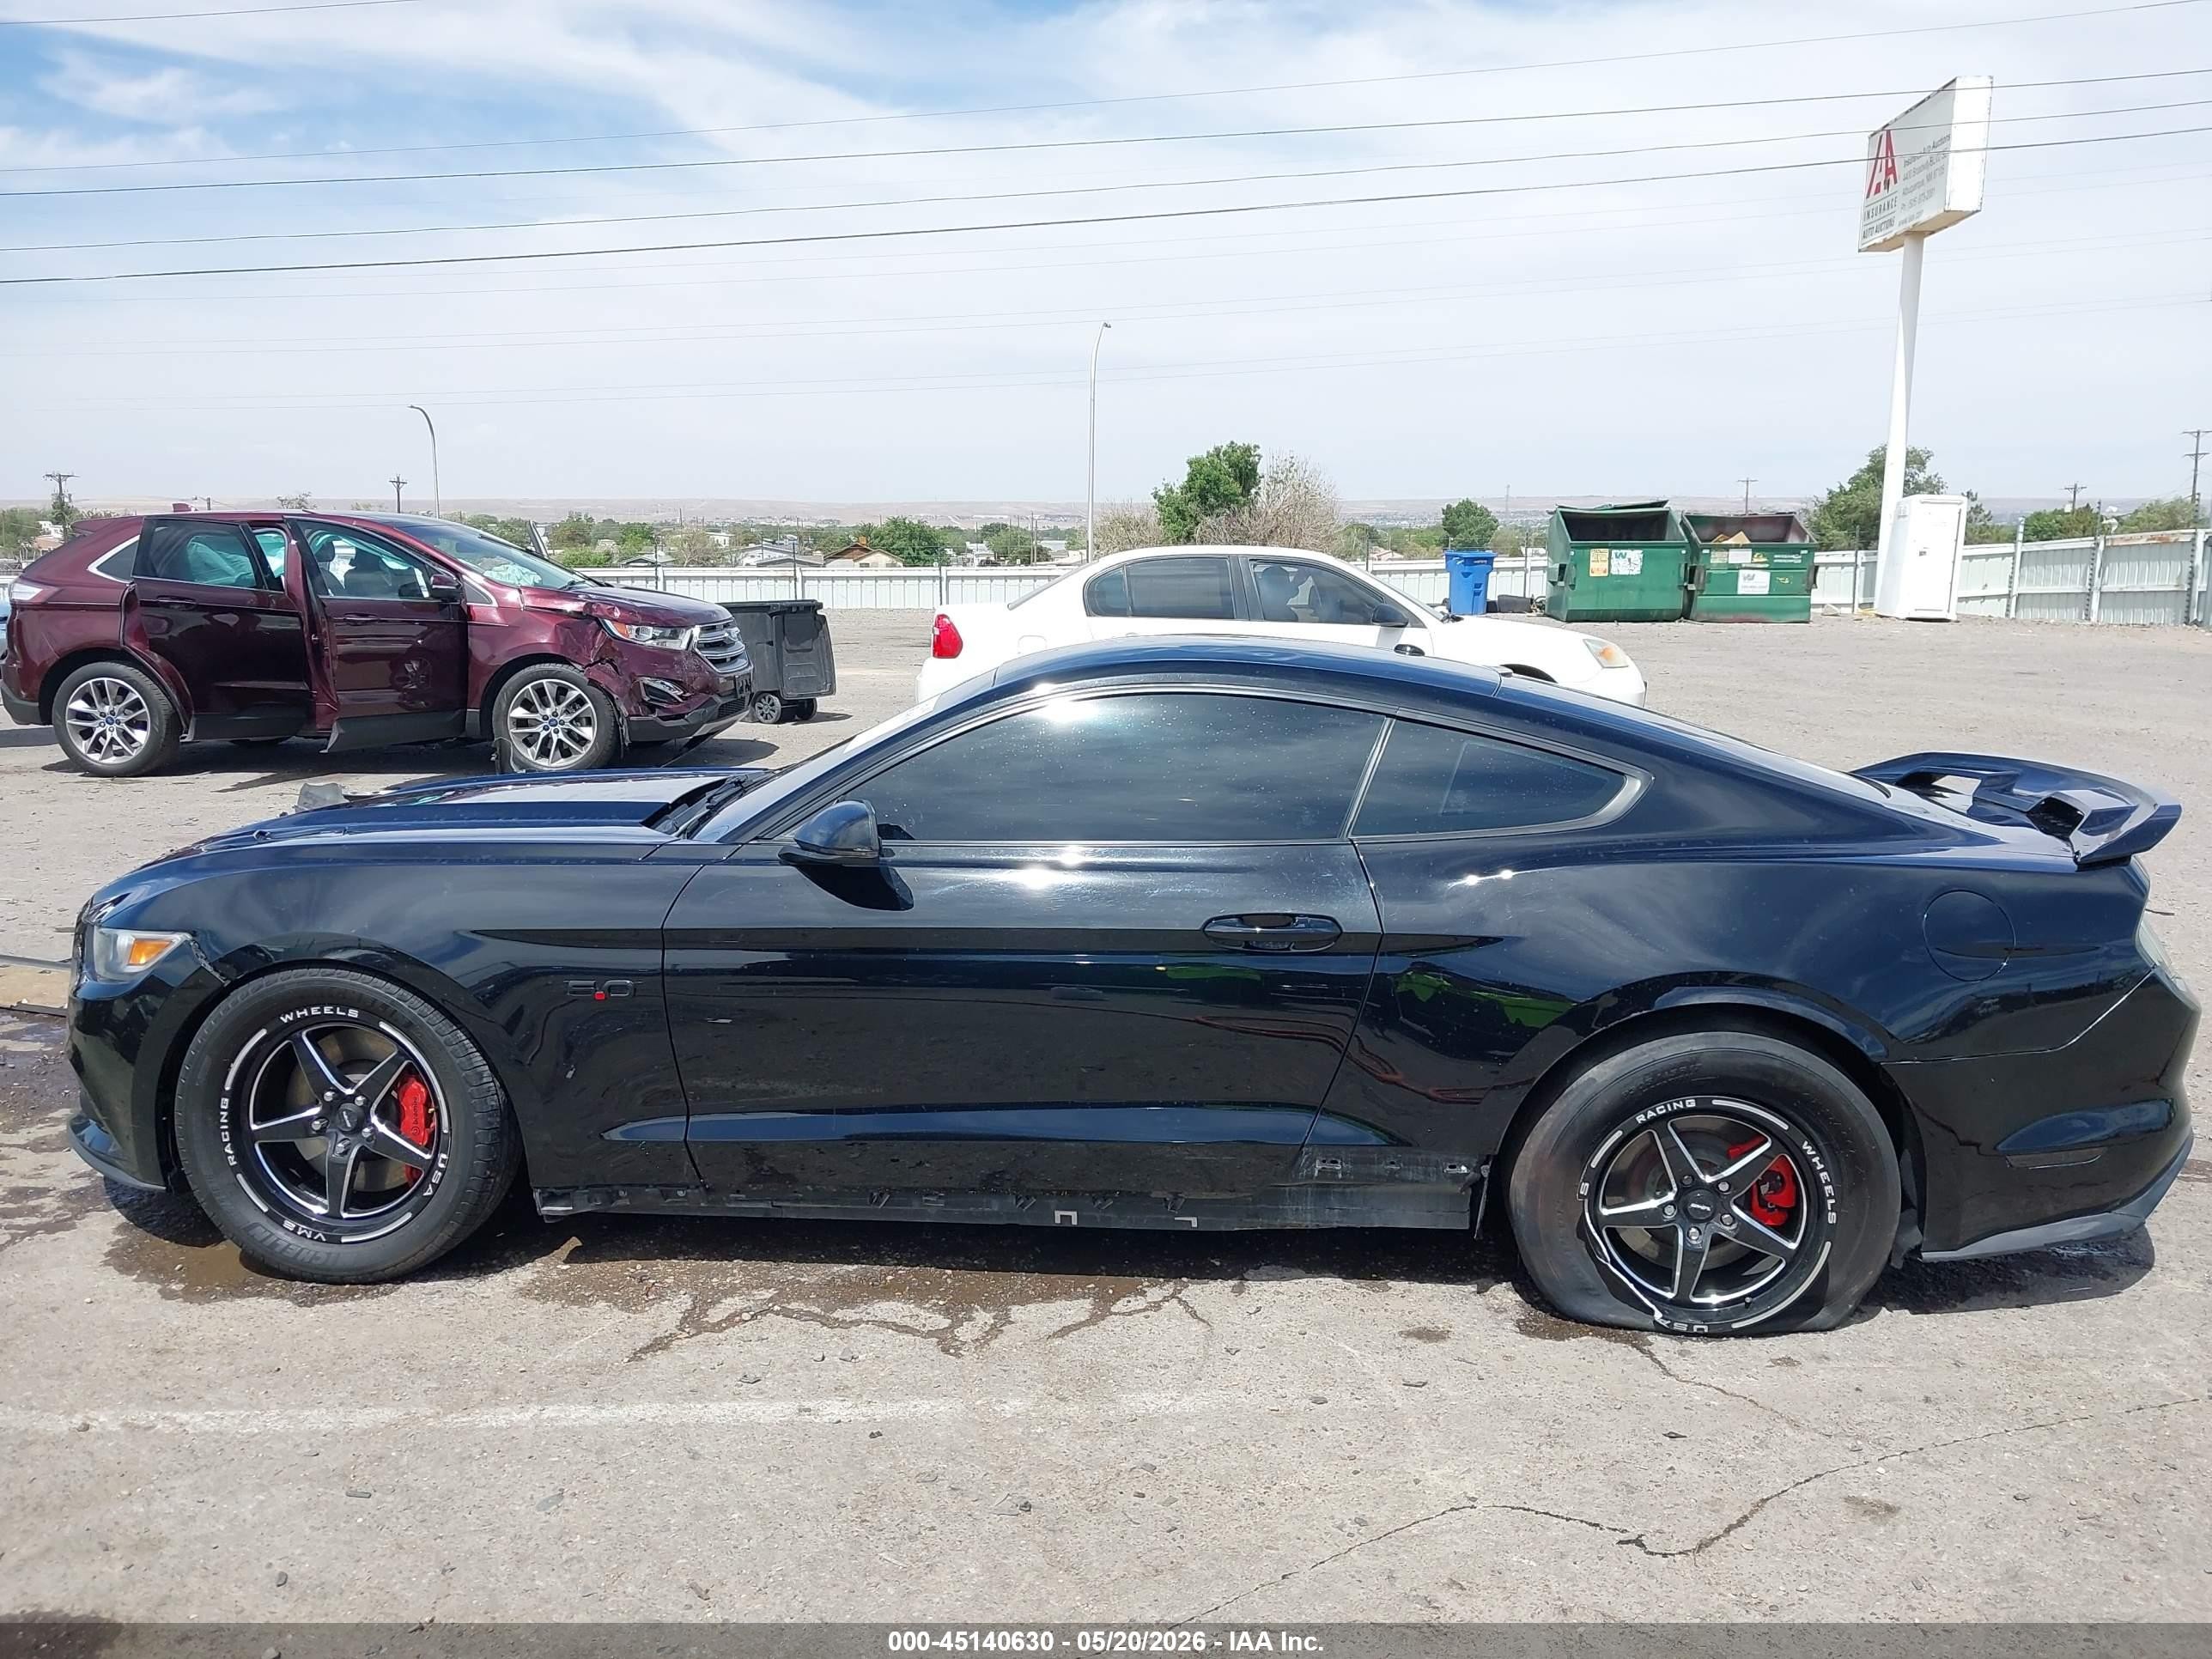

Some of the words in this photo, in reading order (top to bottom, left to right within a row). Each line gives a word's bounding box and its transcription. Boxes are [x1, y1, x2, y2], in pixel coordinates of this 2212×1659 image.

[1863, 196, 1898, 222] INSURANCE
[1863, 227, 1875, 240] AUTO
[1875, 216, 1895, 234] AUCTIONS
[280, 1006, 359, 1023] WHEELS
[1636, 1099, 1696, 1123] RACING
[220, 1097, 237, 1166] RACING
[422, 1152, 449, 1197] USA
[1802, 1140, 1836, 1224] WHEELS
